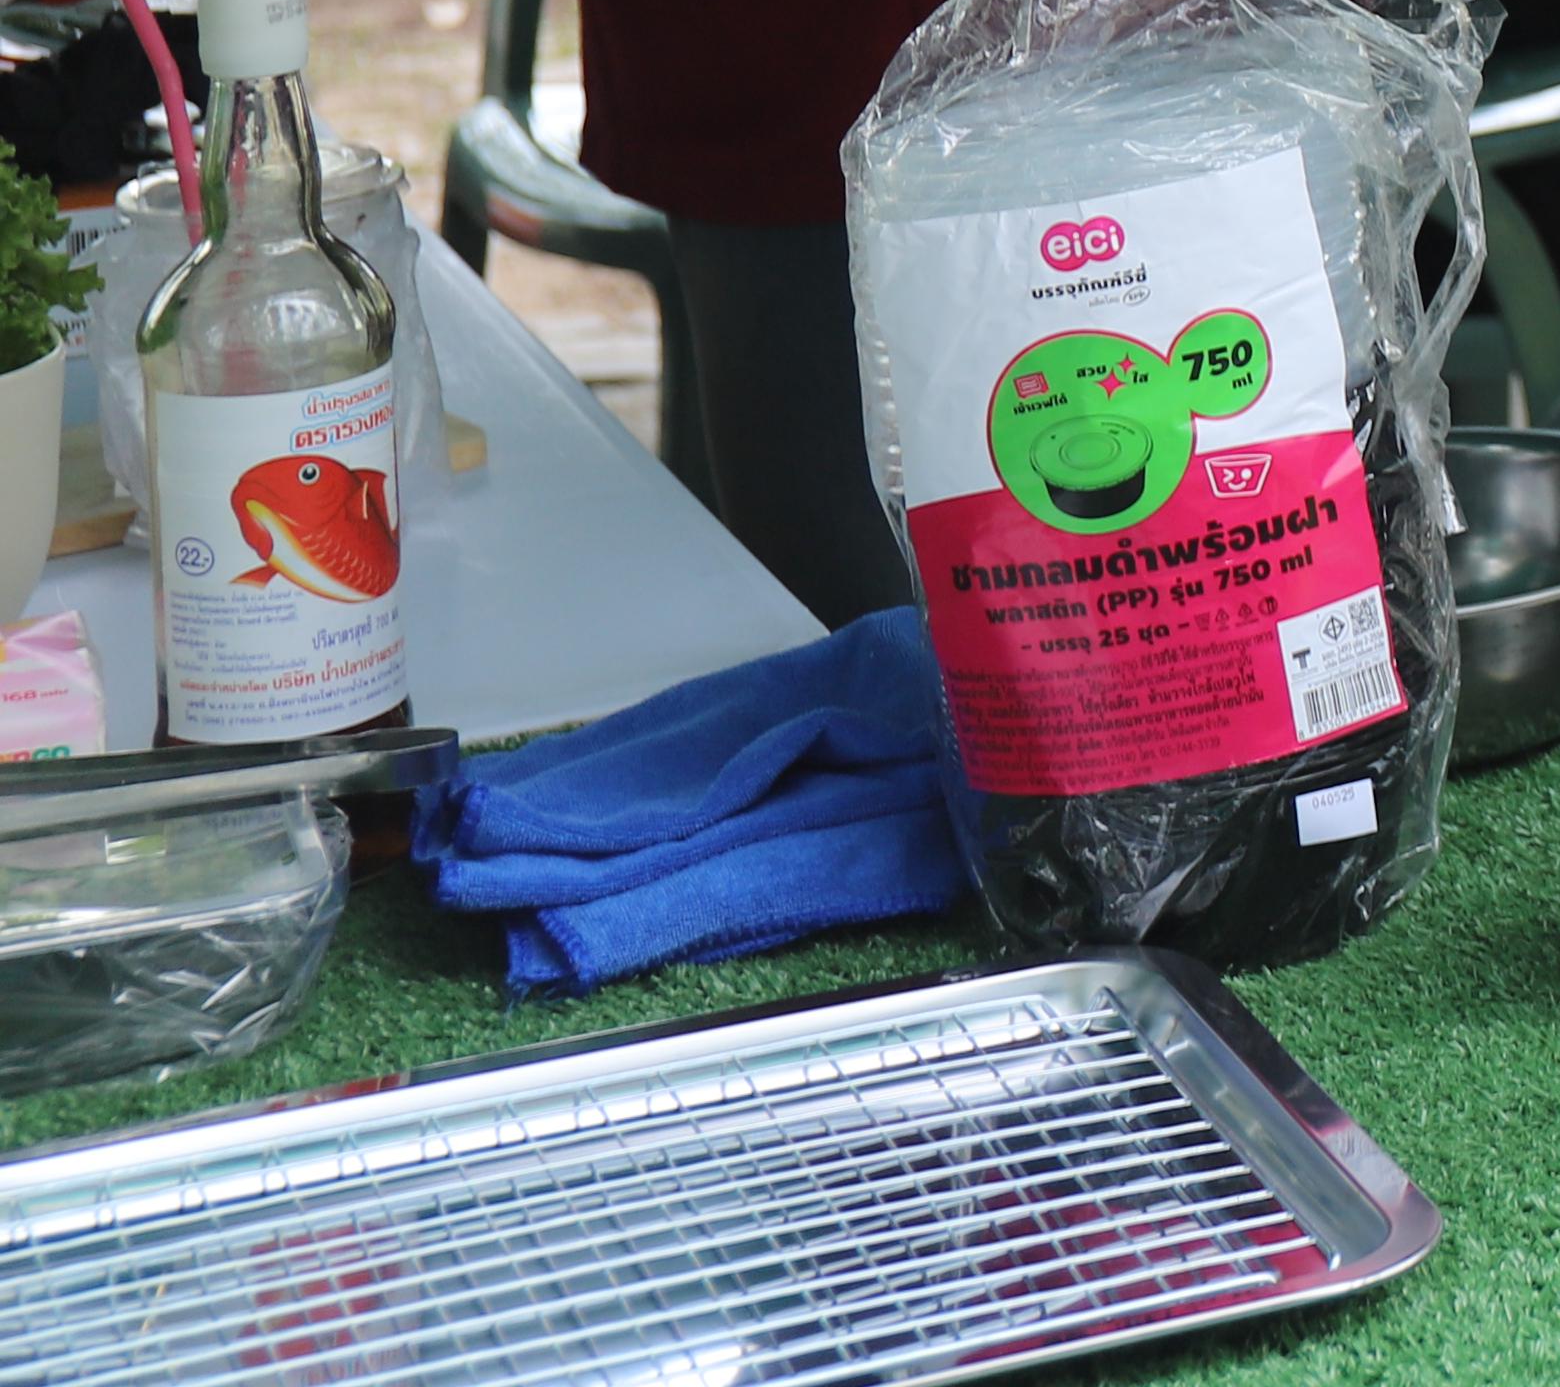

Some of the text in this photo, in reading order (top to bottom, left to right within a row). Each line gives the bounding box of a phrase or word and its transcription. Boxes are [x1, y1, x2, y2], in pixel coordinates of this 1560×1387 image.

[1047, 225, 1120, 262] eici
[1076, 363, 1108, 379] สวย
[1181, 339, 1254, 390] 750 ml
[179, 545, 210, 569] 22.-
[951, 494, 1339, 594] ชามกลมดำพร้อมฝา
[985, 546, 1314, 627] พลาสติก (PP) รุ่น 750 ml
[1039, 637, 1093, 657] บรรจุ
[1099, 627, 1131, 648] 25
[1138, 623, 1171, 646] ชุด
[272, 668, 316, 692] บริษัท
[1311, 787, 1356, 810] 040525
